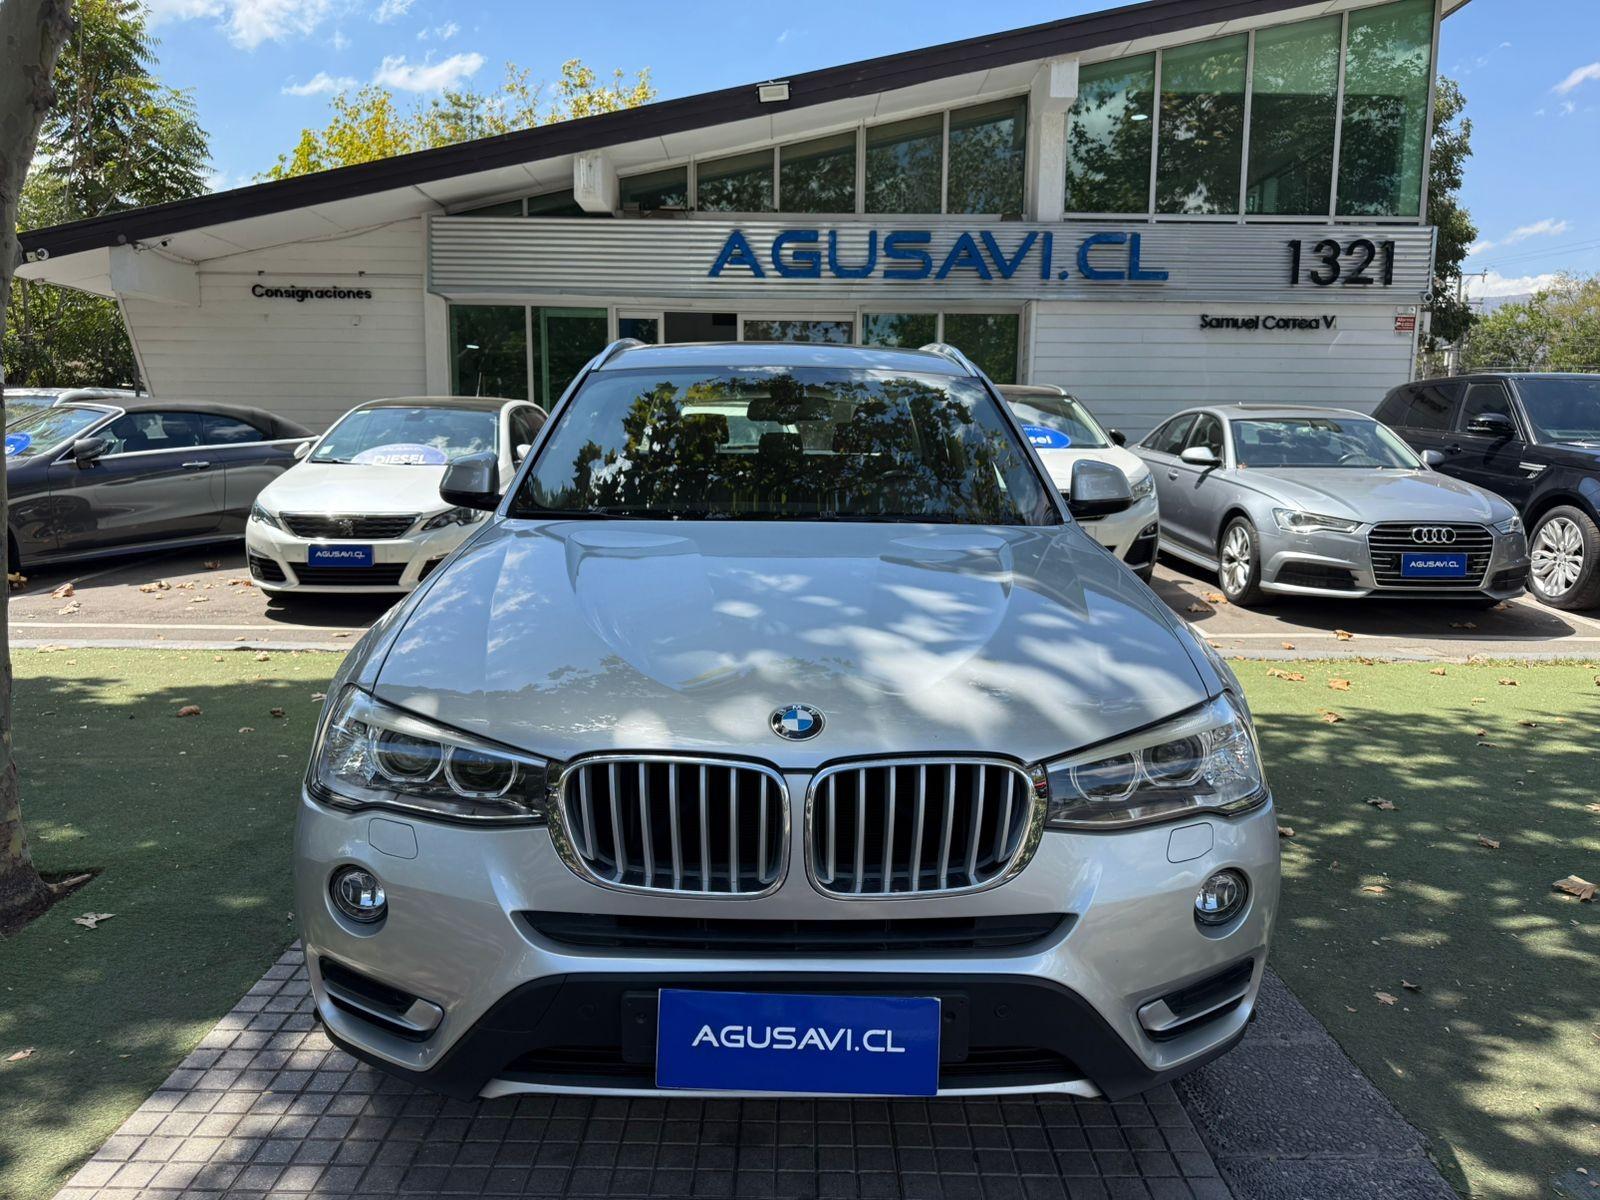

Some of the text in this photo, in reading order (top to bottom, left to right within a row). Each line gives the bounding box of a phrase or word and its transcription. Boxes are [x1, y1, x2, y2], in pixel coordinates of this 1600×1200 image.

[708, 229, 1169, 281] AGUSAVI.CL
[1288, 239, 1395, 286] 1321
[252, 284, 372, 302] Consignaciones
[1200, 314, 1260, 330] Samuel
[1262, 315, 1320, 330] Correa
[315, 550, 366, 559] AGUSAVI.CL
[1409, 560, 1460, 568] AGUSAVI.CL
[691, 1024, 906, 1053] AGUSAVI.CL
